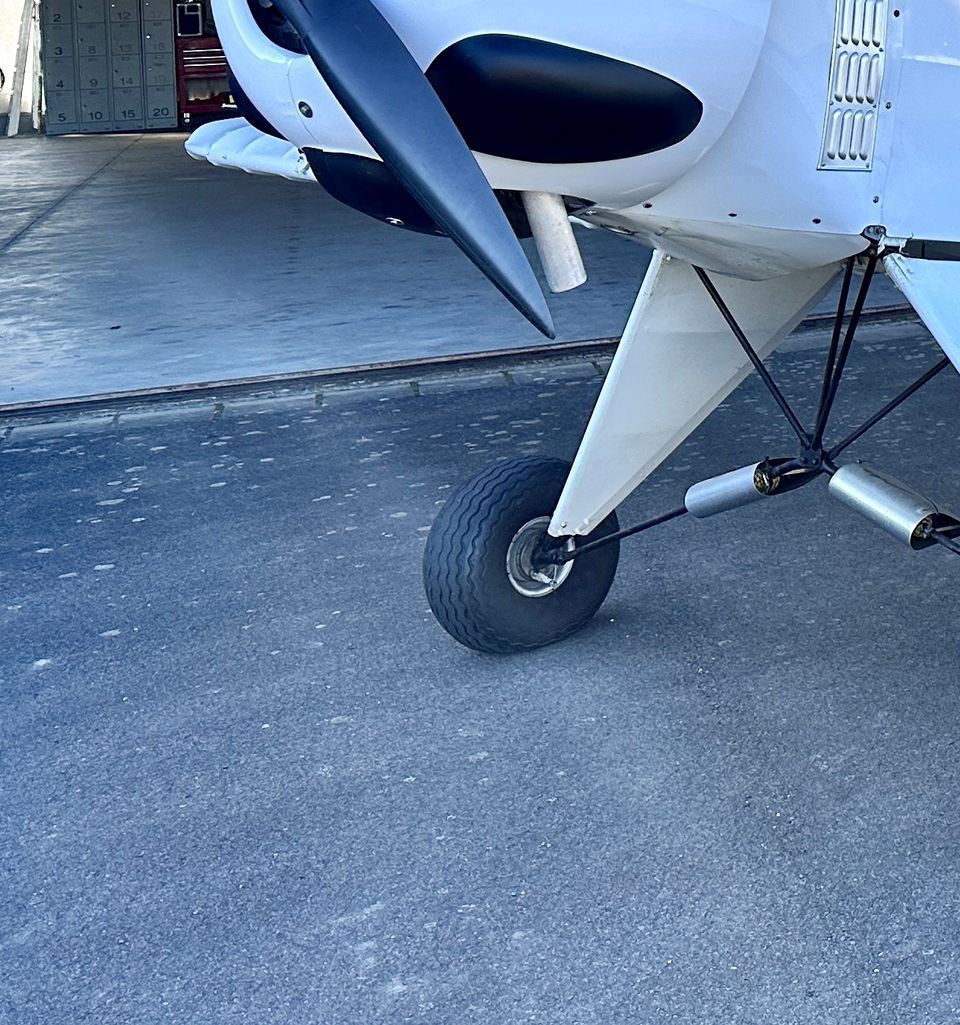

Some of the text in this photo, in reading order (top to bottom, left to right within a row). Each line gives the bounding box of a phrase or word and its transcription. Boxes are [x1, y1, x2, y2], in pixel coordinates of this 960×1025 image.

[53, 14, 61, 23] 2
[118, 11, 131, 20] 12
[54, 46, 63, 56] 3
[88, 45, 96, 54] 8
[56, 80, 64, 88] 4
[89, 78, 98, 87] 9
[121, 77, 133, 85] 14
[89, 111, 103, 120] 10
[121, 109, 136, 119] 15
[153, 107, 169, 117] 20
[58, 113, 66, 122] 5
